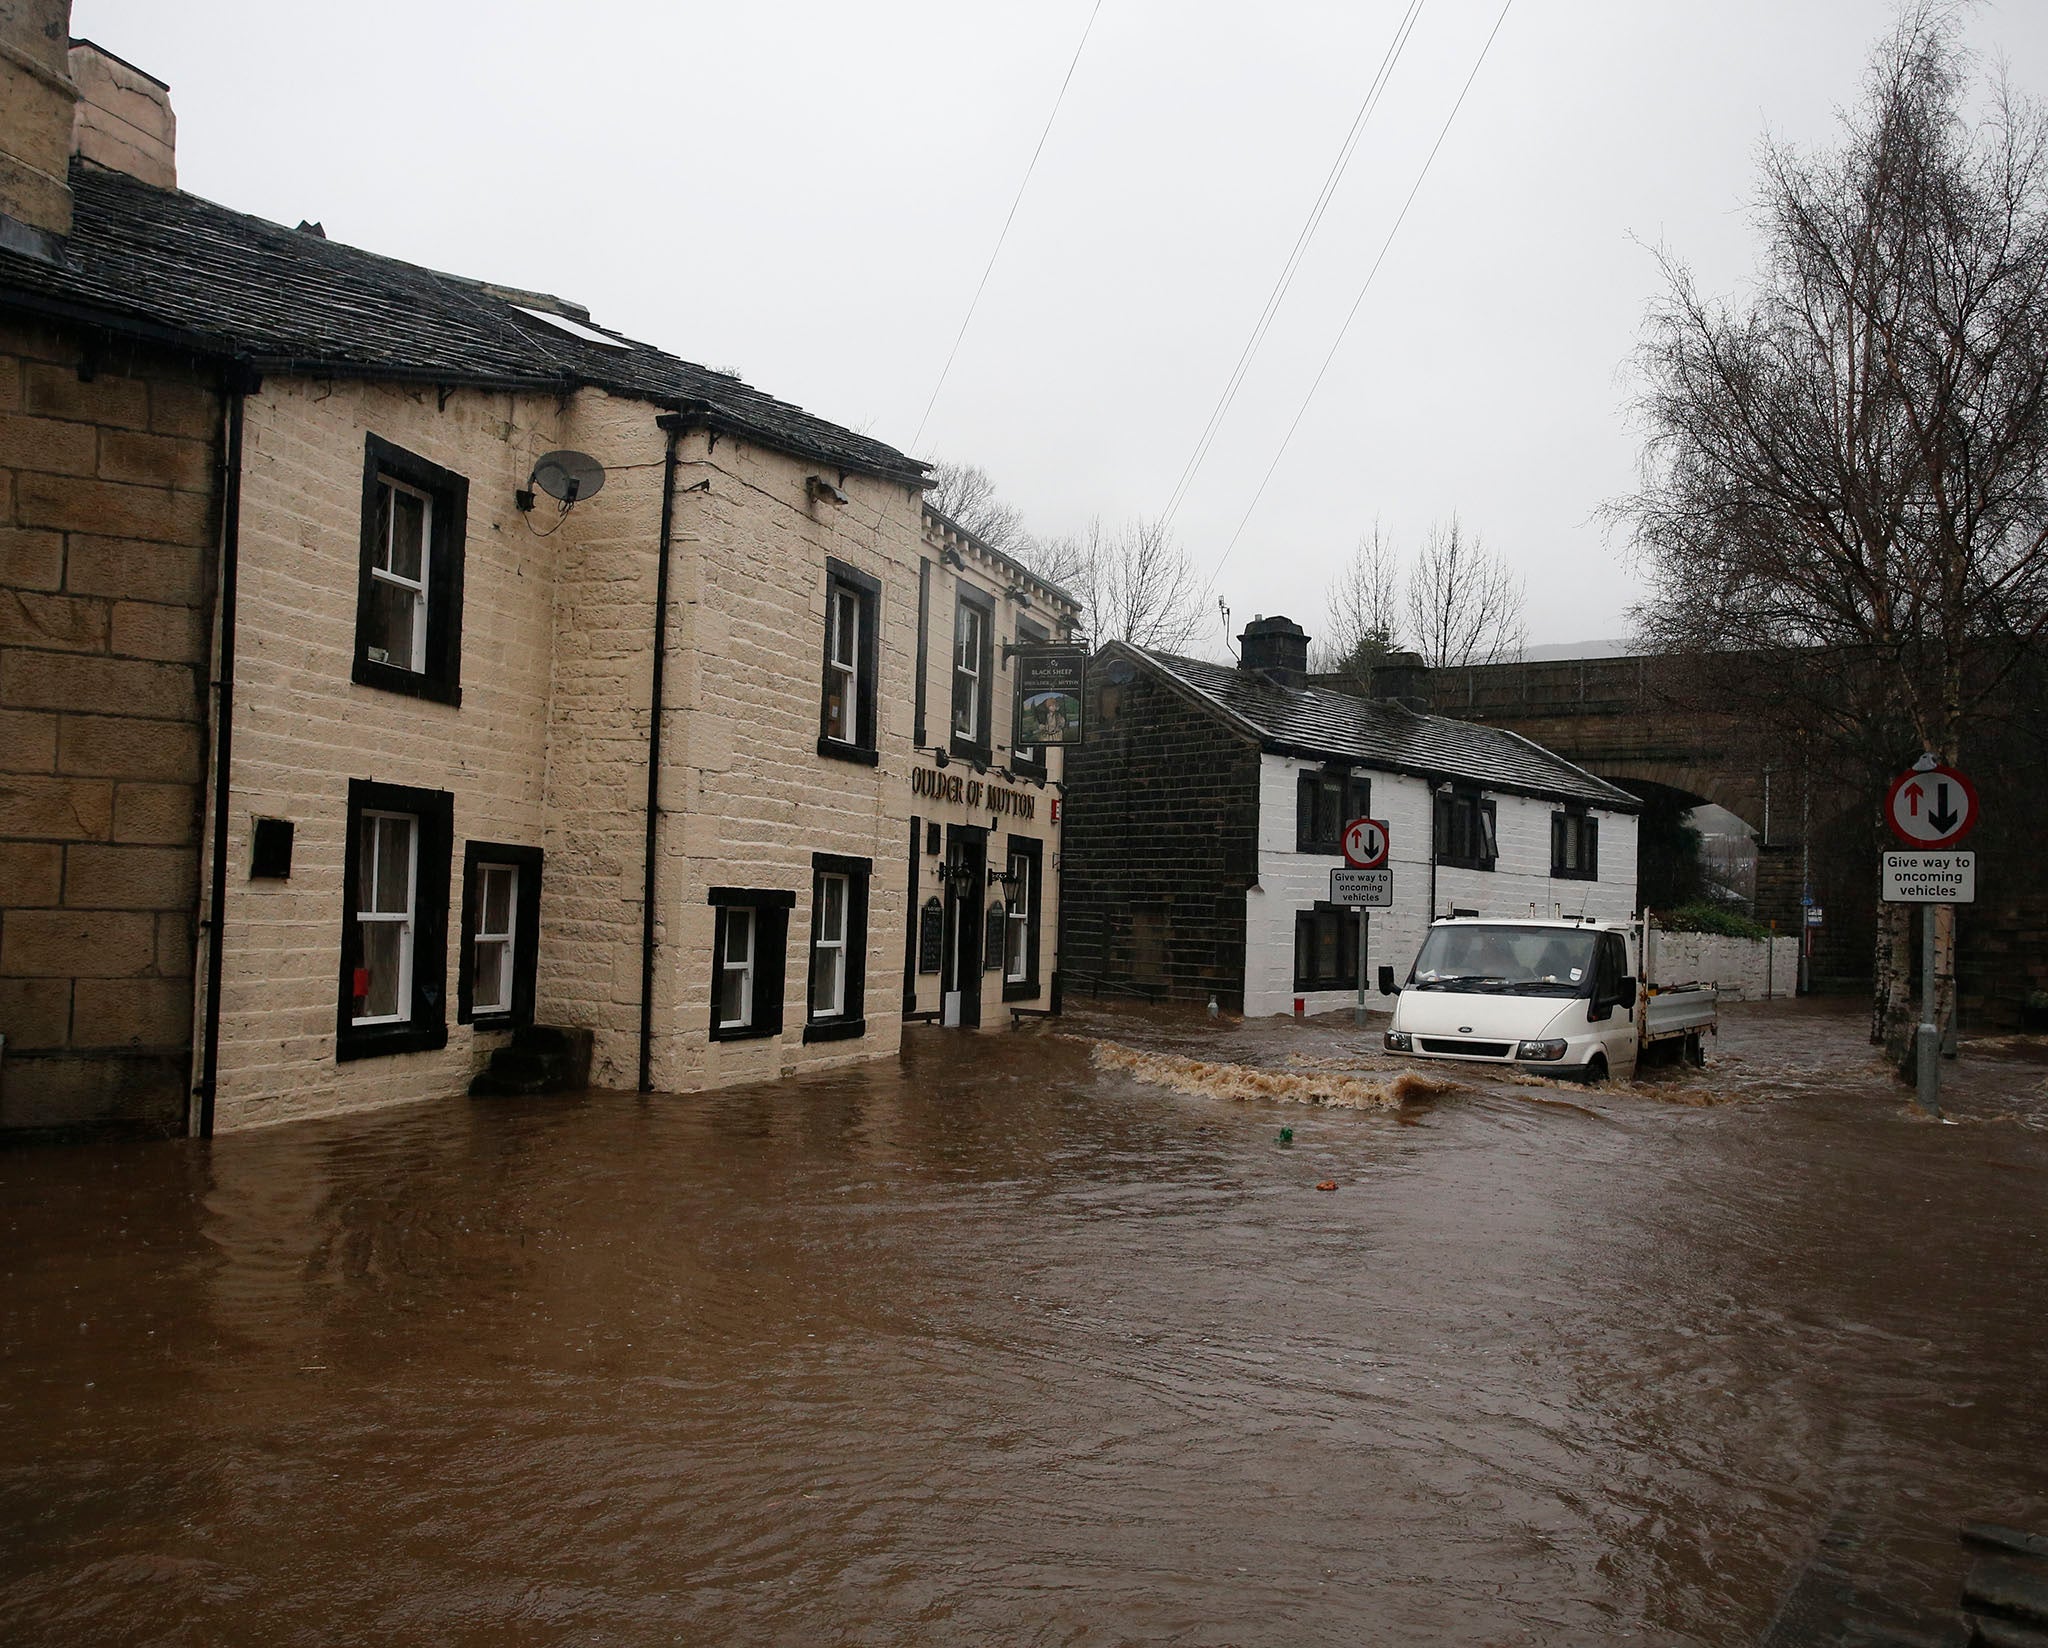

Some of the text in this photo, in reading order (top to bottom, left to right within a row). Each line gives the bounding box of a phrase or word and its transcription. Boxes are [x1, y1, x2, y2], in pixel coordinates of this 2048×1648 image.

[966, 779, 984, 808] OF
[985, 784, 1035, 820] MUTTON
[1888, 856, 1970, 869] Give way to
[1335, 873, 1354, 881] Give
[1894, 871, 1962, 884] oncoming
[1340, 884, 1382, 893] oncoming
[1900, 885, 1957, 896] vehicles
[1343, 893, 1379, 901] vehicles
